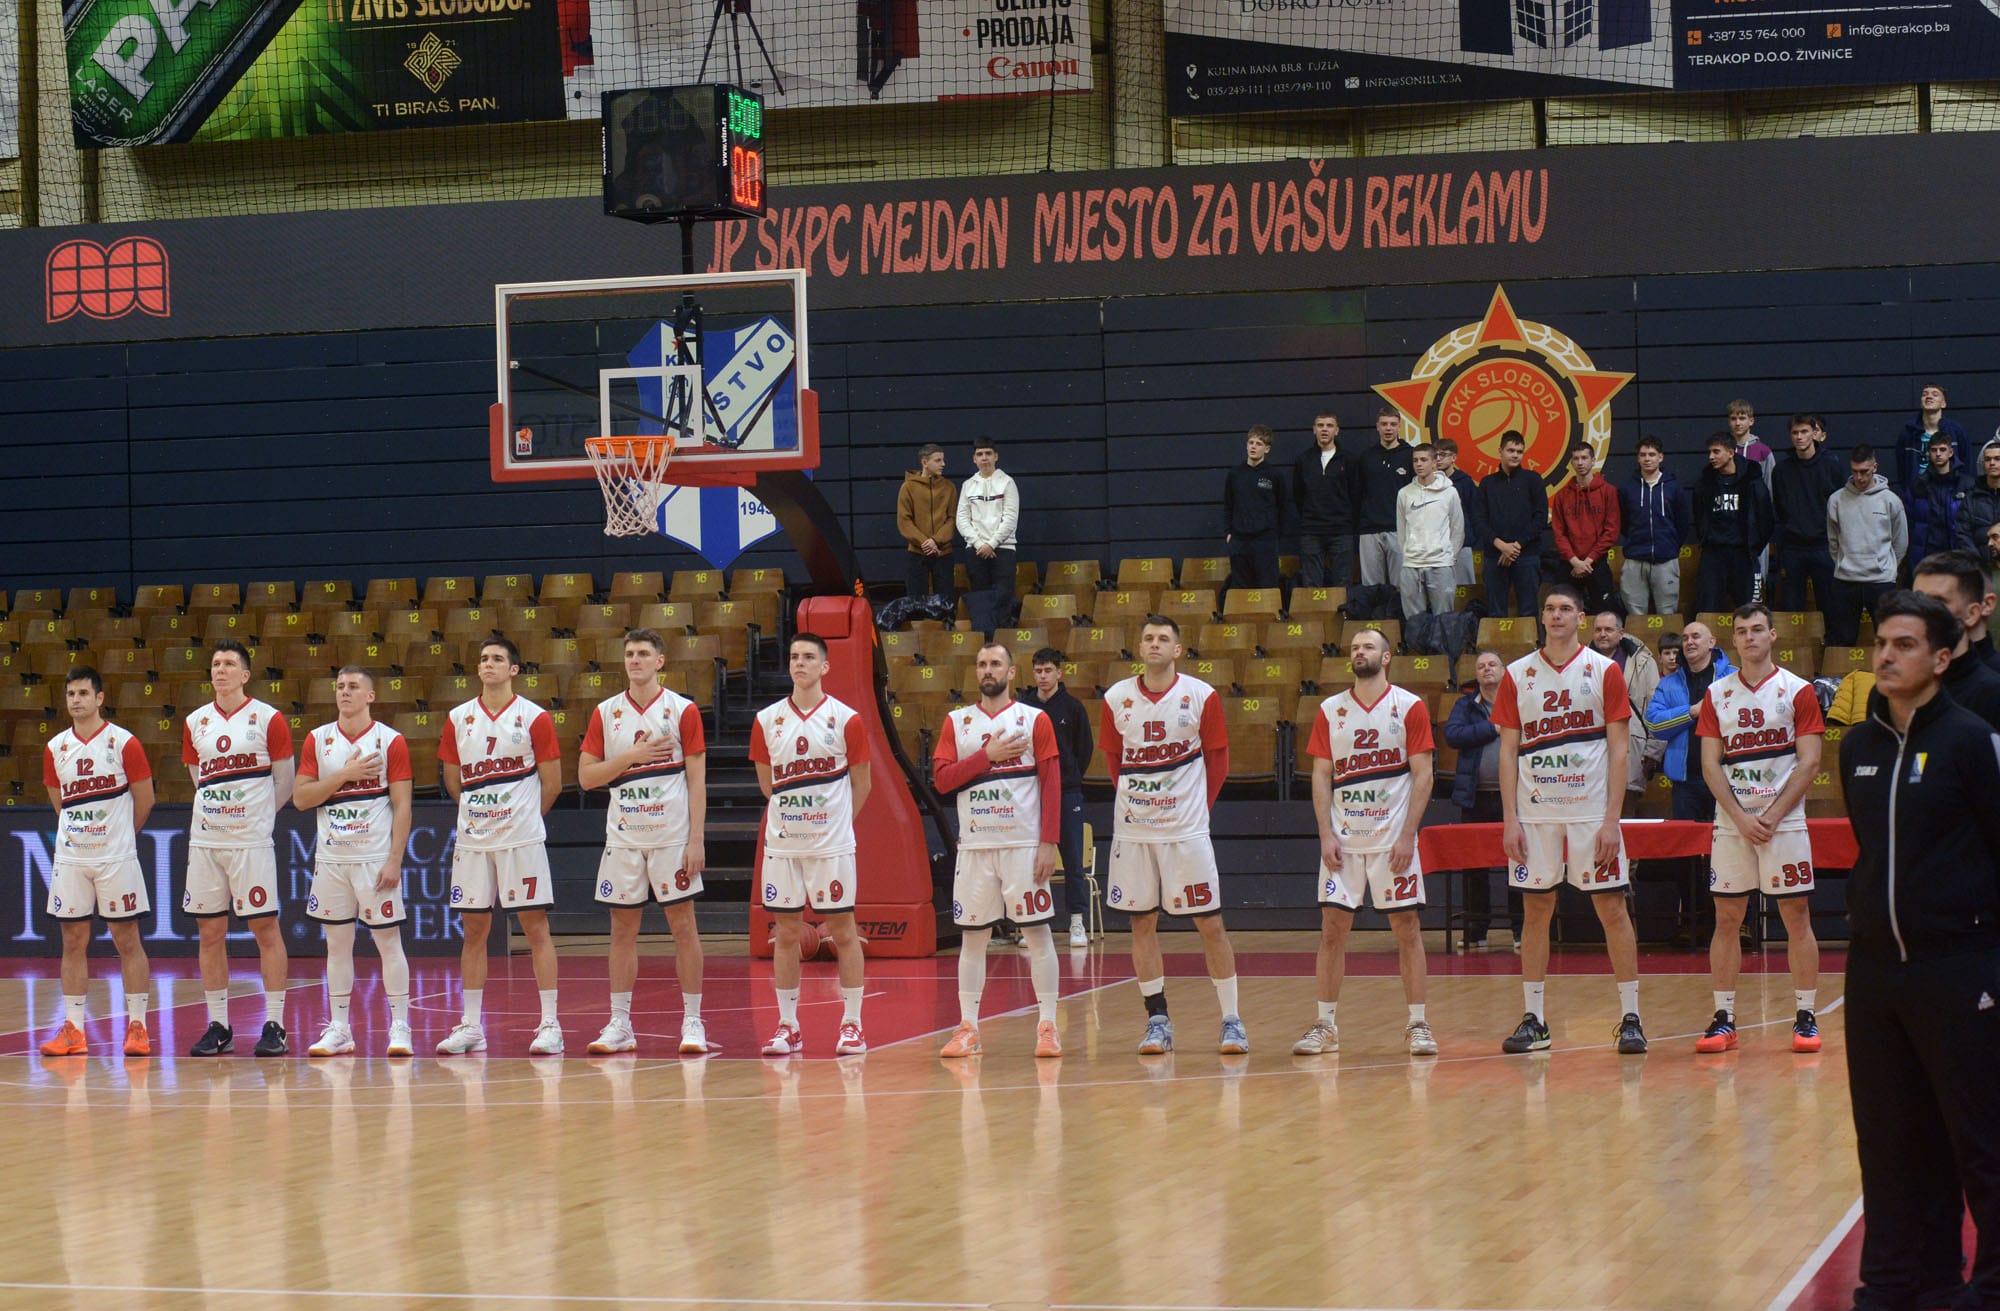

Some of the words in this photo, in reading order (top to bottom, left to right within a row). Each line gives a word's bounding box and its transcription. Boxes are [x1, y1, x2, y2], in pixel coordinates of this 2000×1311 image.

[976, 14, 1074, 48] PRODAJA
[1707, 30, 1735, 42] +387
[1738, 28, 1753, 41] 35
[1756, 27, 1779, 40] 764
[1782, 26, 1805, 39] 000
[1848, 21, 1951, 38] info@terakop.ba
[1688, 52, 1751, 66] TERAKOP
[1754, 50, 1793, 64] D.O.O.
[1797, 46, 1853, 62] ŽIVINICE
[987, 56, 1078, 79] Canon
[1207, 66, 1247, 77] KULINA
[1250, 64, 1278, 74] BANA
[1308, 61, 1340, 71] TUZLA
[75, 66, 133, 124] LAGER
[1207, 84, 1263, 96] 035/249-111
[372, 103, 389, 117] TI
[707, 219, 747, 273] JP
[756, 206, 851, 278] SKPC
[861, 197, 1009, 275] MEJDAN
[1033, 184, 1179, 264] MJESTO
[1187, 182, 1239, 257] ZA
[1250, 158, 1353, 255] VAŠU
[1363, 168, 1548, 250] REKLAMU
[1447, 383, 1476, 426] OKK
[1477, 369, 1561, 423] SLOBODA
[445, 578, 456, 590] 12
[504, 576, 517, 587] 13
[694, 572, 708, 585] 16
[213, 586, 220, 596] 8
[1312, 589, 1328, 602] 24
[1182, 594, 1195, 604] 22
[662, 605, 676, 617] 16
[722, 602, 734, 613] 17
[287, 614, 298, 626] 10
[351, 614, 361, 625] 11
[409, 612, 420, 624] 12
[468, 610, 481, 622] 13
[524, 608, 537, 621] 14
[1718, 615, 1733, 627] 30
[1791, 615, 1804, 625] 31
[48, 622, 55, 632] 6
[228, 617, 236, 627] 9
[1498, 618, 1513, 632] 27
[1647, 616, 1664, 630] 29
[1017, 631, 1032, 642] 20
[1092, 628, 1104, 640] 21
[1288, 625, 1302, 637] 24
[887, 635, 900, 646] 18
[952, 632, 965, 645] 19
[563, 640, 576, 651] 15
[1779, 650, 1793, 662] 31
[1850, 649, 1864, 661] 32
[1065, 663, 1078, 676] 21
[1198, 663, 1212, 673] 23
[1413, 657, 1430, 670] 26
[588, 674, 602, 687] 16
[921, 668, 934, 680] 19
[270, 682, 281, 693] 11
[390, 679, 402, 691] 13
[455, 679, 467, 690] 14
[525, 675, 539, 689] 15
[24, 687, 31, 697] 7
[145, 684, 152, 695] 9
[1244, 701, 1260, 712] 30
[1543, 689, 1572, 712] 24
[417, 714, 428, 727] 14
[554, 712, 566, 725] 16
[1524, 709, 1595, 740] SLOBODA
[1738, 708, 1765, 728] 33
[1143, 721, 1166, 742] 15
[1825, 729, 1841, 740] 32
[216, 735, 232, 753] 0
[486, 736, 497, 755] 7
[796, 735, 809, 755] 9
[1354, 729, 1379, 749] 22
[1725, 727, 1789, 751] LOBODA
[76, 758, 94, 776] 12
[1335, 748, 1402, 776] SLOBODA
[1531, 753, 1568, 769] PAN
[461, 756, 525, 780] SLOBODA
[774, 757, 835, 781] SLOBODA
[1533, 773, 1585, 785] TransTurist
[1731, 768, 1761, 782] PAN
[1128, 779, 1161, 792] PAN
[203, 790, 231, 801] PAN
[468, 793, 498, 805] PAN
[620, 787, 649, 800] PAN
[969, 788, 1000, 802] PAN
[1342, 789, 1376, 803] PAN
[779, 795, 813, 808] PAN
[1128, 795, 1177, 806] TransTurist
[202, 805, 245, 815] TransTurist
[328, 808, 358, 820] PAN
[468, 807, 512, 819] TransTurist
[619, 803, 664, 814] TransTurist
[970, 806, 1014, 815] TransTurist
[1344, 807, 1390, 817] TransTurist
[66, 810, 93, 822] PAN
[780, 811, 828, 823] TransTurist
[66, 824, 107, 835] TransTurist
[1594, 857, 1620, 884] 24
[1782, 861, 1812, 887] 33
[674, 868, 690, 891] 8
[522, 877, 537, 900] 7
[829, 879, 843, 903] 9
[1184, 882, 1212, 908] 15
[122, 892, 137, 913] 12
[248, 886, 267, 908] 0
[1024, 888, 1051, 916] 10
[380, 900, 394, 919] 6
